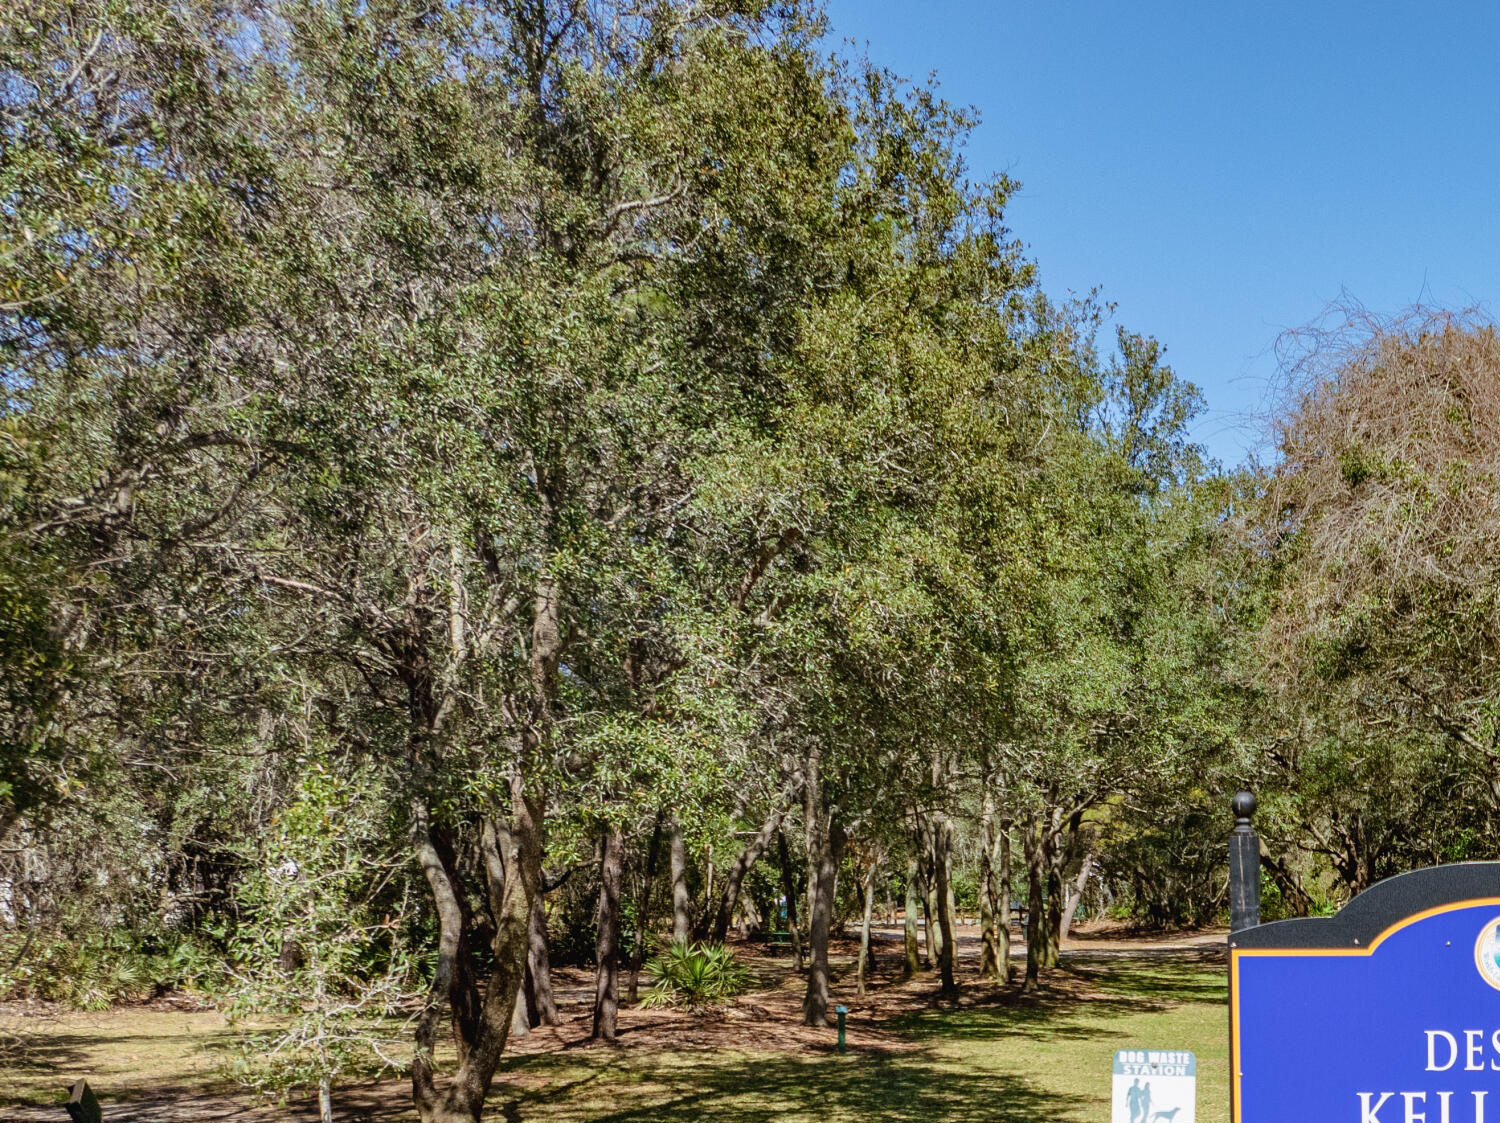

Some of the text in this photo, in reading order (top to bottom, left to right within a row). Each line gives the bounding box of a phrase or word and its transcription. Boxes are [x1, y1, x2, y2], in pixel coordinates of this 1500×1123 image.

[1119, 1051, 1190, 1064] DOG WASTE
[1123, 1065, 1186, 1076] STATION
